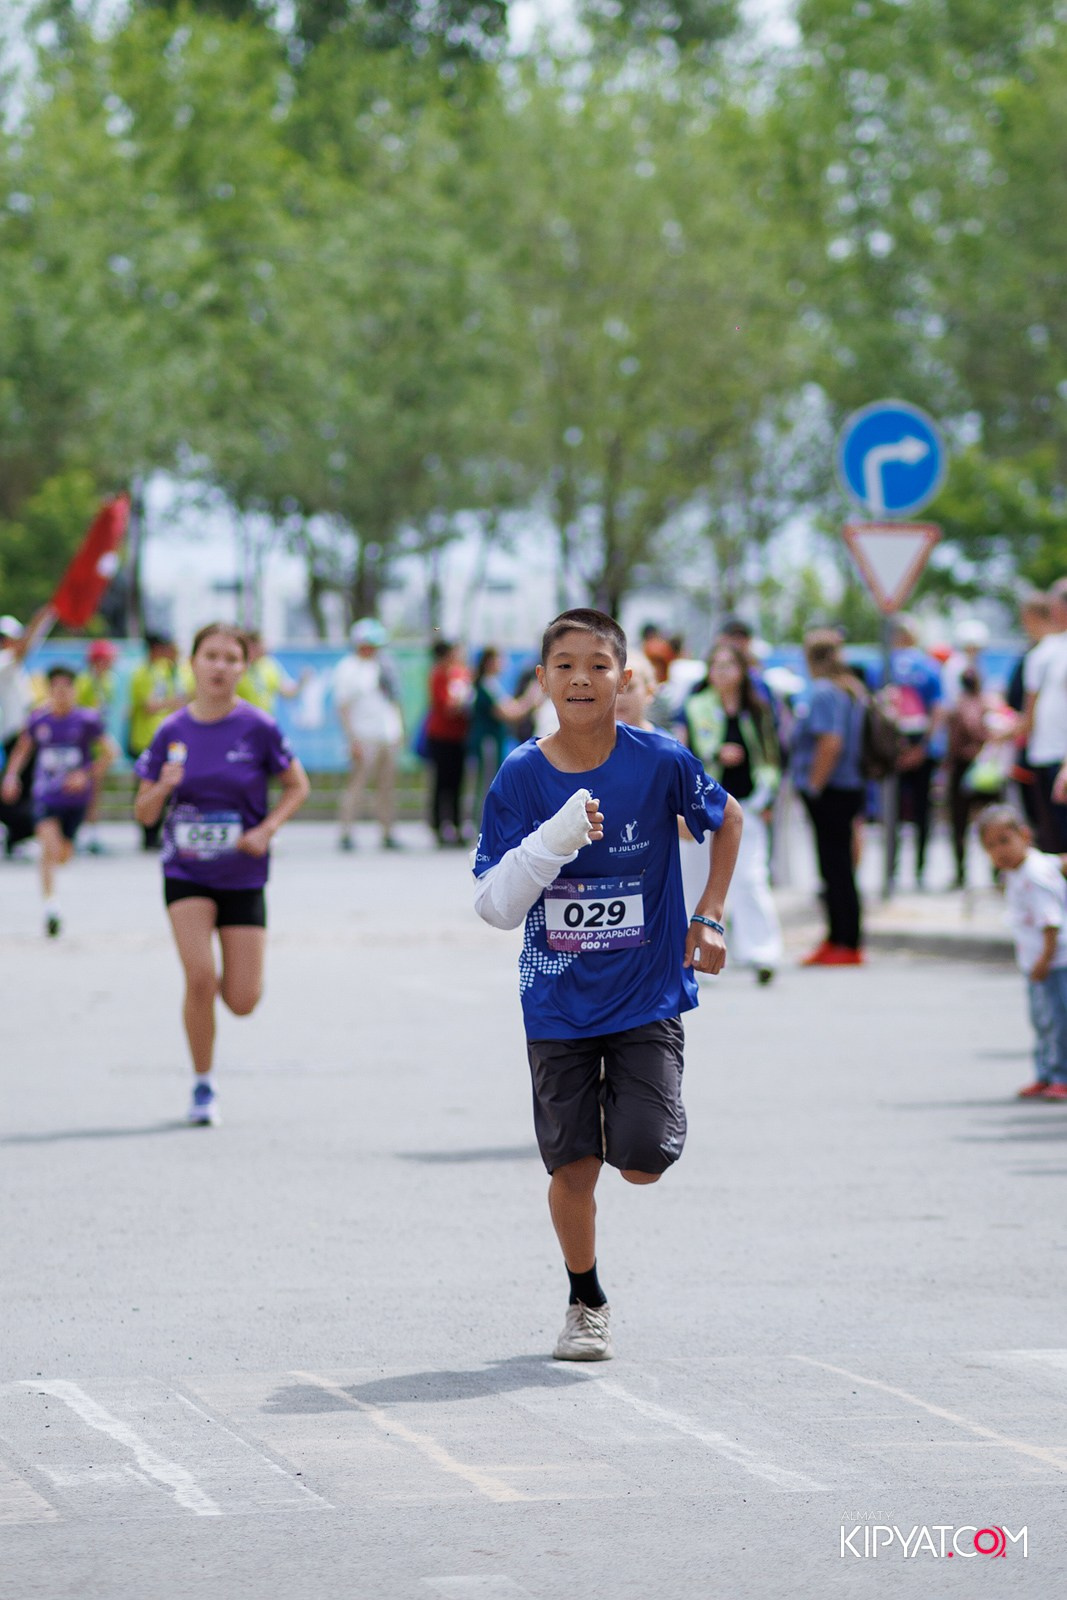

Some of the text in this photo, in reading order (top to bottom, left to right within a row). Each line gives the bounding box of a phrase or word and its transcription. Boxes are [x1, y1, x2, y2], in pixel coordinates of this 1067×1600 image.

[563, 900, 626, 928] 029
[549, 927, 641, 940] БАЛАЛАР ЖАРЫСЫ
[580, 941, 601, 950] 600
